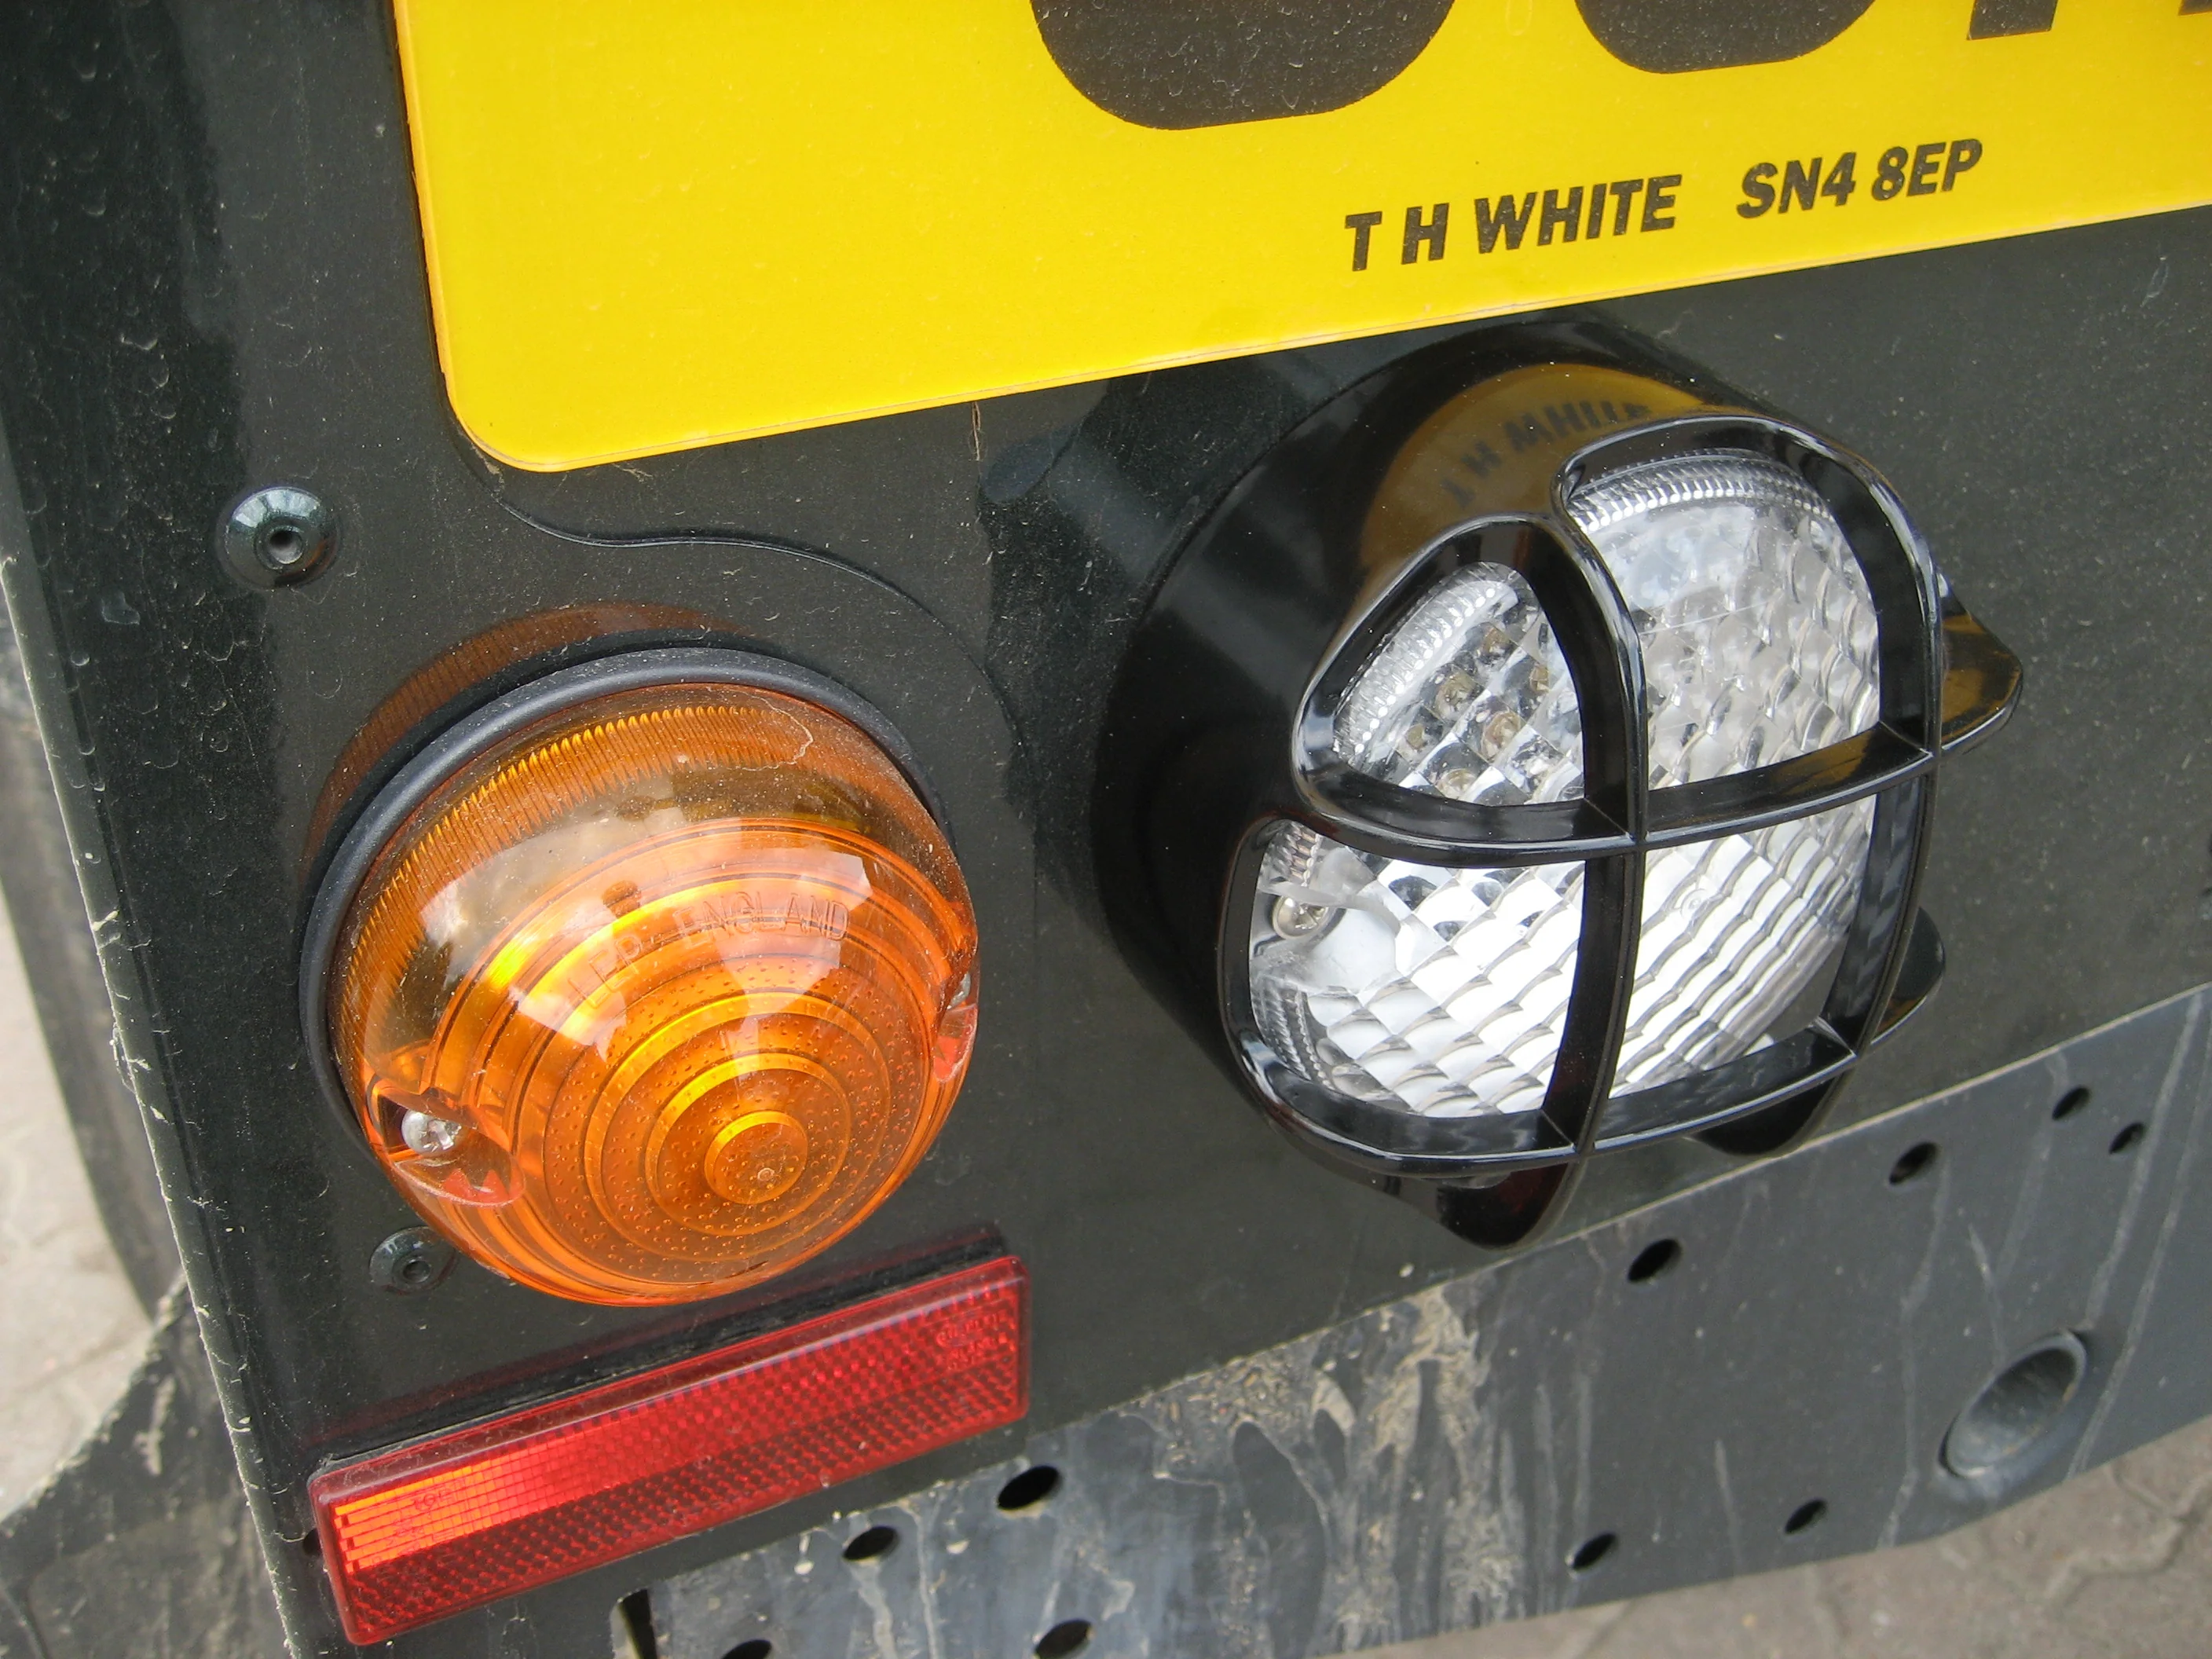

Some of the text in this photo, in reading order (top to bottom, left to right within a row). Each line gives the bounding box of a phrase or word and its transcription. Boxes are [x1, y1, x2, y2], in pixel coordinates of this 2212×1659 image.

[1345, 138, 1983, 272] T H WHITE SN4 8EP
[672, 890, 851, 950] ENGLAND
